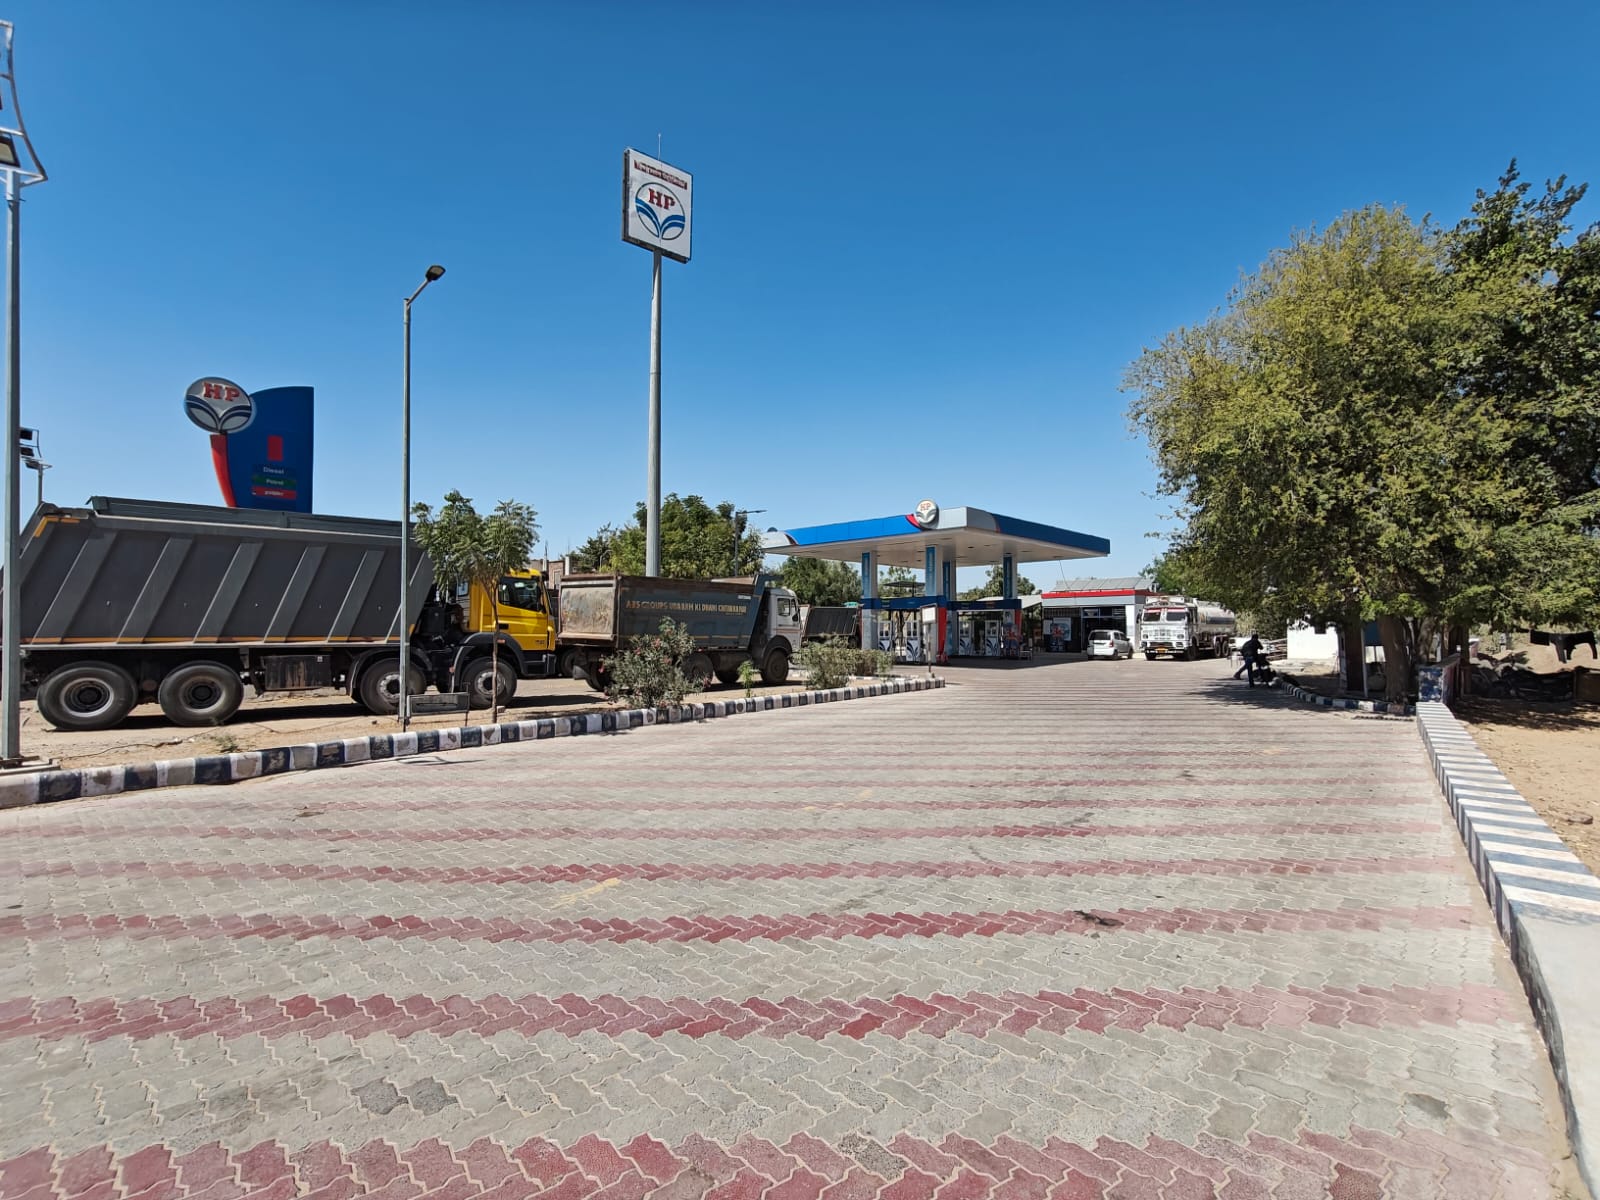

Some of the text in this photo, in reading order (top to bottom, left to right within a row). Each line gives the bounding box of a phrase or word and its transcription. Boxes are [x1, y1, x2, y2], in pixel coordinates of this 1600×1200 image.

[648, 188, 676, 210] HP
[203, 382, 240, 401] HP
[263, 466, 284, 475] Diesel
[920, 502, 932, 511] HP
